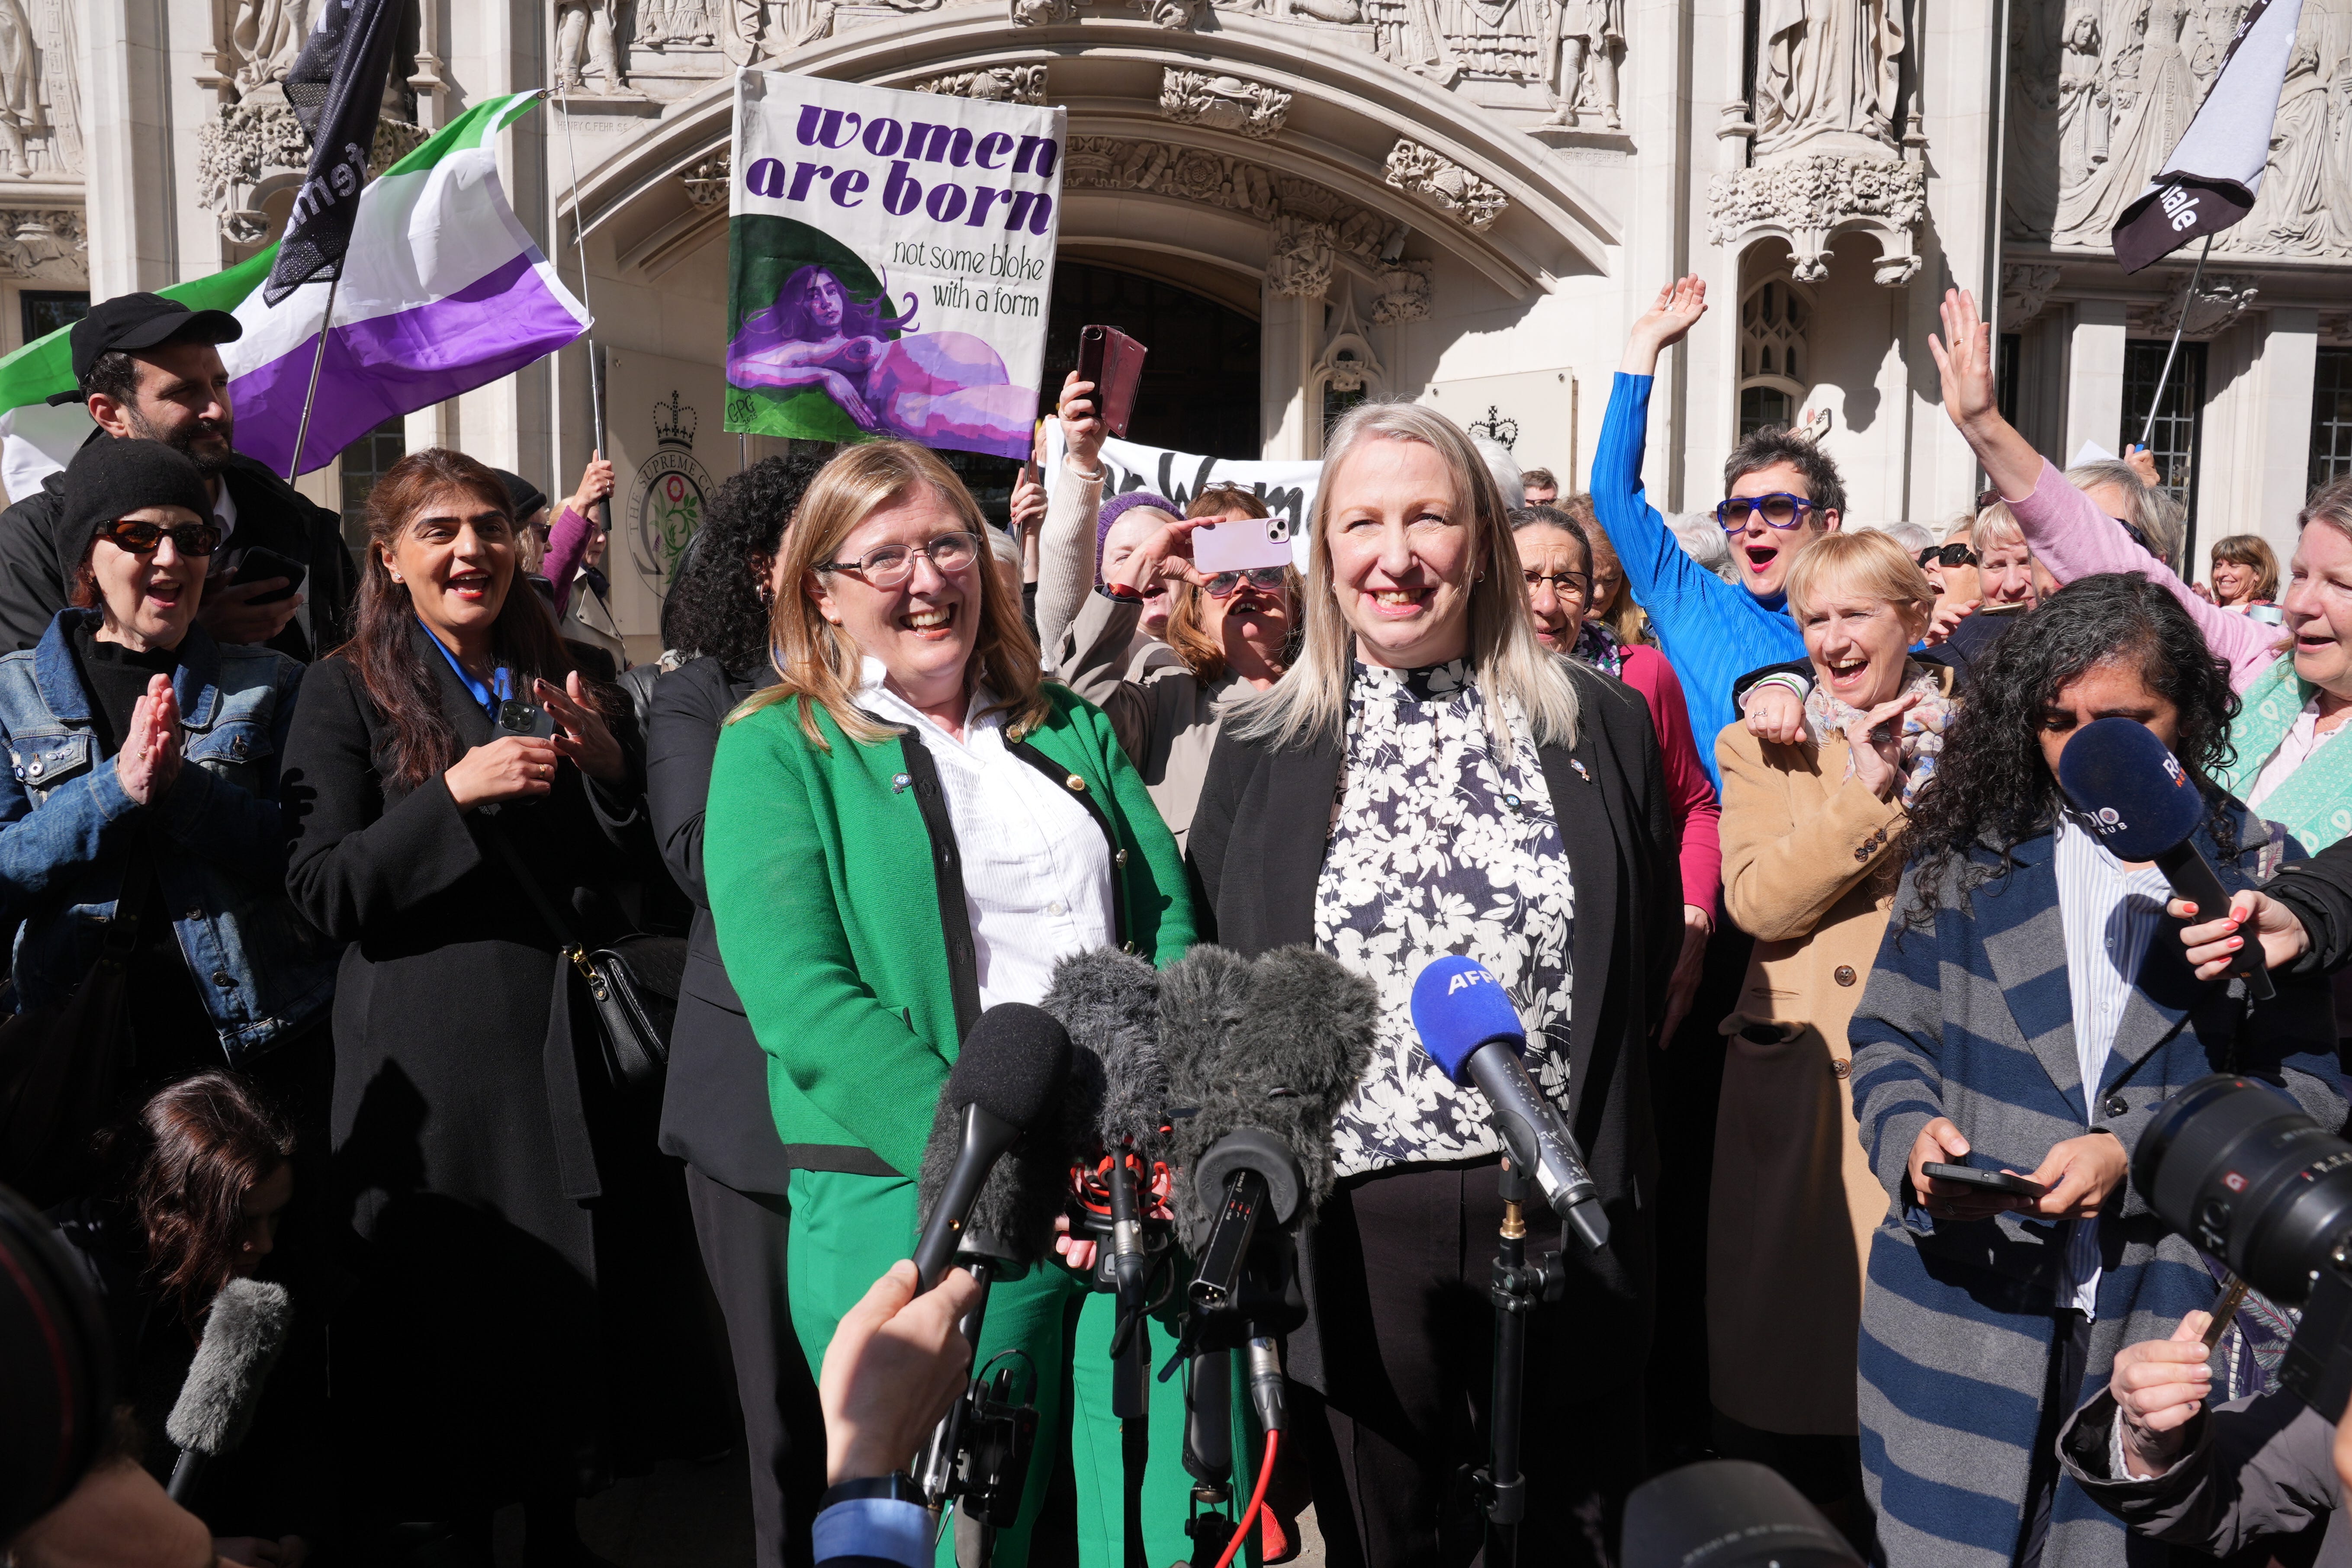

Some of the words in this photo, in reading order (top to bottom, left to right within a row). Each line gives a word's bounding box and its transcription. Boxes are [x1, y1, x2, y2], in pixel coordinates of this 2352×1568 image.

[797, 104, 1058, 178] women
[746, 157, 870, 208] are
[883, 161, 1052, 235] born
[893, 241, 926, 266] not
[930, 247, 985, 273] some
[990, 243, 1044, 280] bloke
[933, 276, 969, 309] with
[976, 290, 988, 312] a
[994, 287, 1039, 317] form
[629, 492, 641, 536] THE
[638, 454, 696, 489] SUPREME
[2098, 822, 2128, 835] HUB
[1447, 970, 1494, 996] AFP
